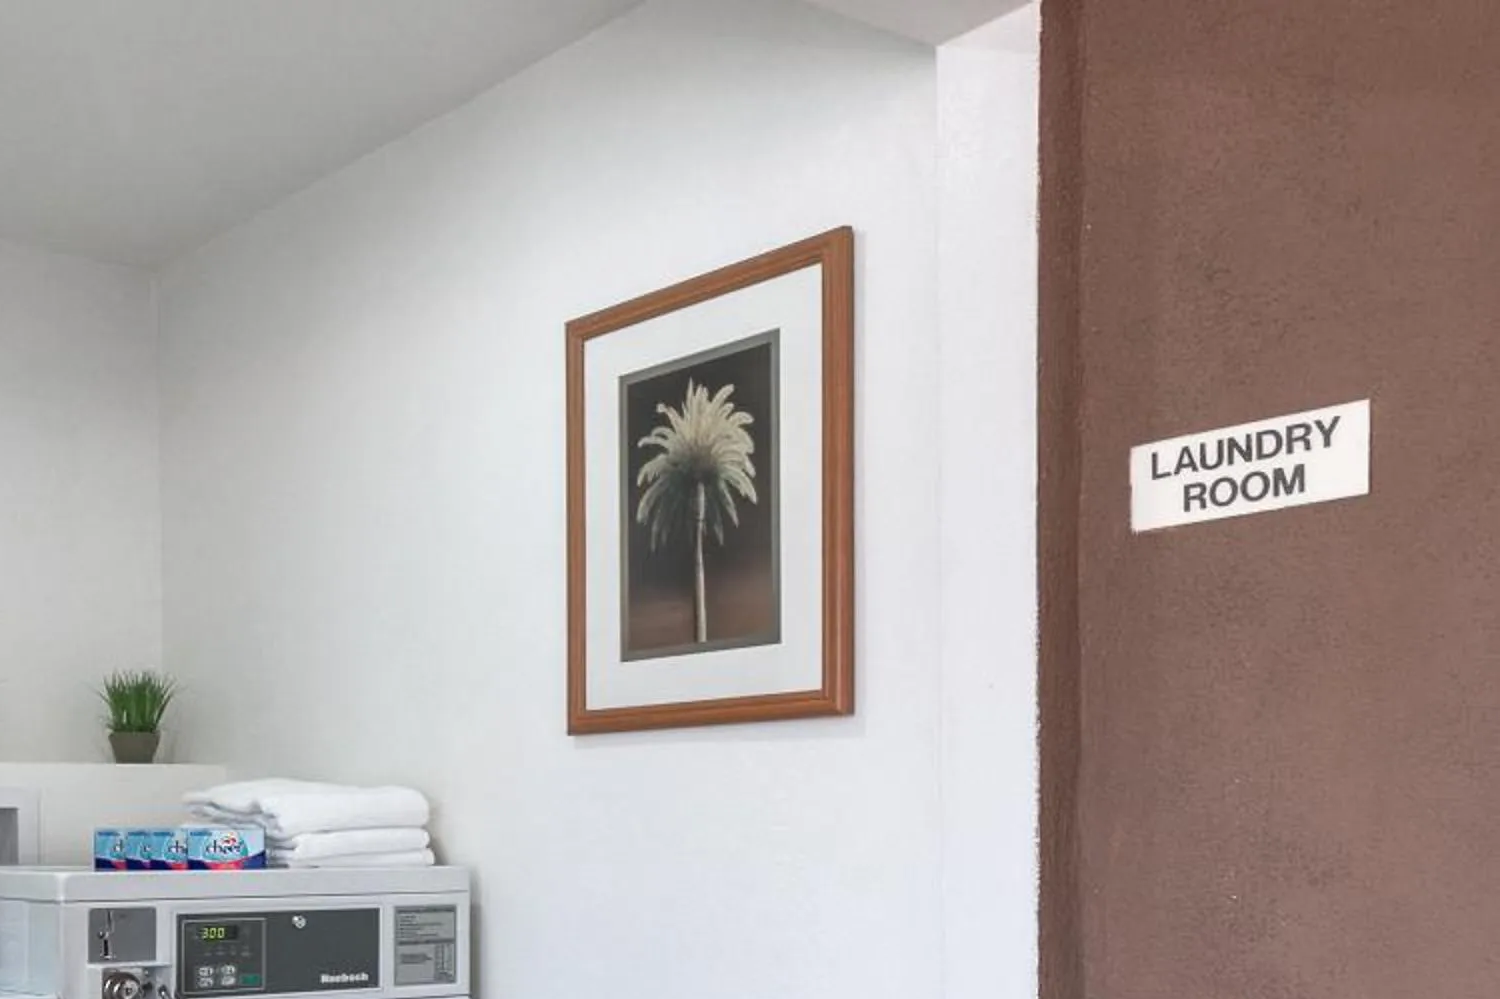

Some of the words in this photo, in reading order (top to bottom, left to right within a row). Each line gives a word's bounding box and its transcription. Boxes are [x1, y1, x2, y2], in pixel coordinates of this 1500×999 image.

[1151, 415, 1341, 480] LAUNDRY
[1183, 463, 1306, 512] ROOM
[201, 926, 226, 939] 300
